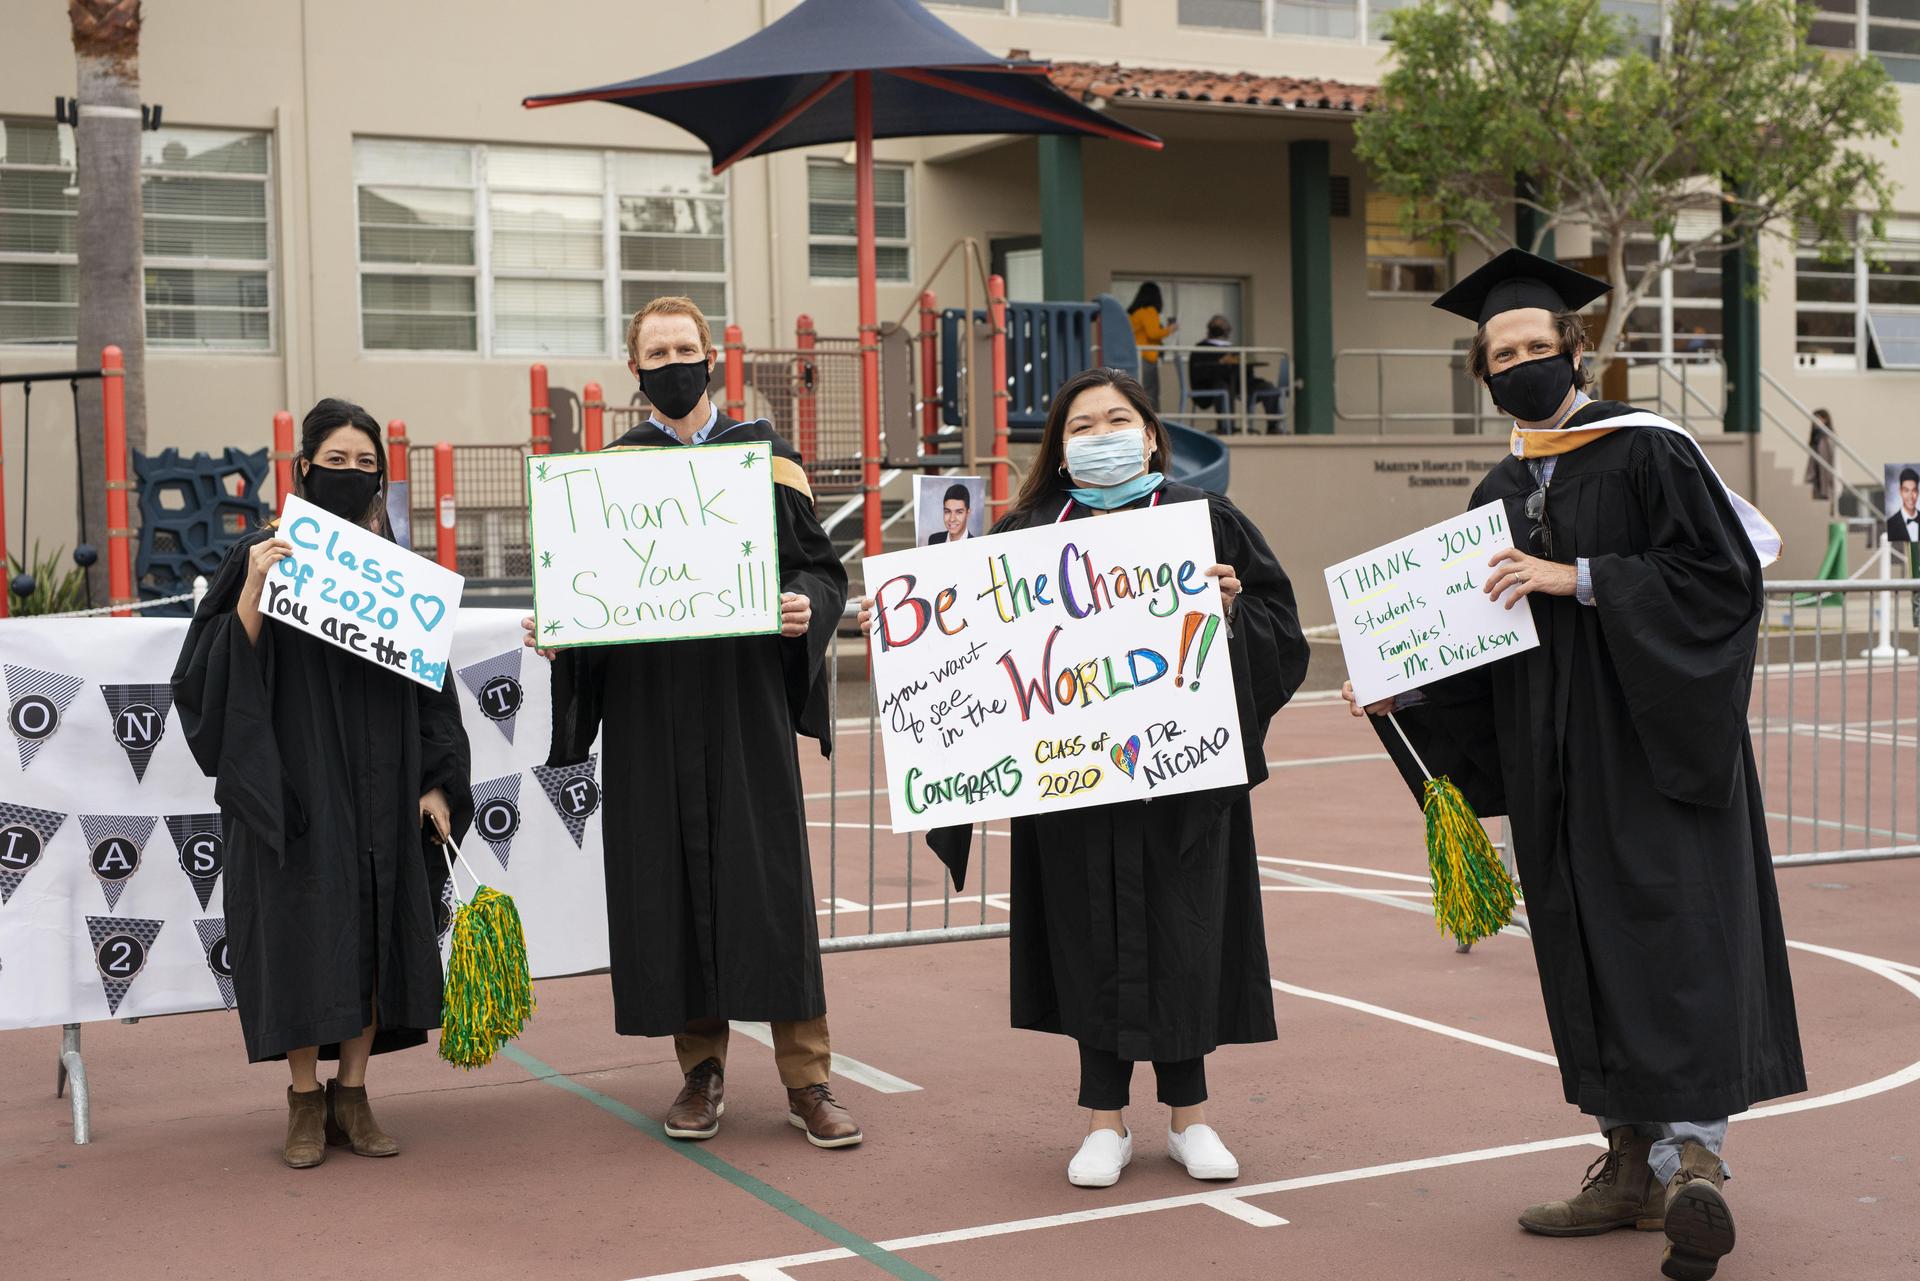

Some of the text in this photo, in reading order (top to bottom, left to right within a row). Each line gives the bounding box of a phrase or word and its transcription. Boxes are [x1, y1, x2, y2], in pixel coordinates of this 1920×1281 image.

[543, 460, 738, 533] Thank
[289, 516, 405, 598] Class
[622, 537, 703, 588] You
[1332, 548, 1421, 600] THANK
[278, 556, 399, 630] of 2020
[873, 542, 1209, 653] Be the Change
[1354, 571, 1478, 636] Students and
[267, 580, 446, 689] You are the Best
[1377, 609, 1451, 661] Families!
[1438, 630, 1519, 667] Dirickson
[881, 641, 988, 733] you want
[903, 688, 973, 744] to see
[938, 726, 964, 748] in
[961, 698, 1007, 728] the
[1091, 732, 1111, 752] of
[1144, 720, 1187, 749] DR.
[904, 755, 1023, 815] CONGRATS
[1036, 766, 1104, 798] 2020
